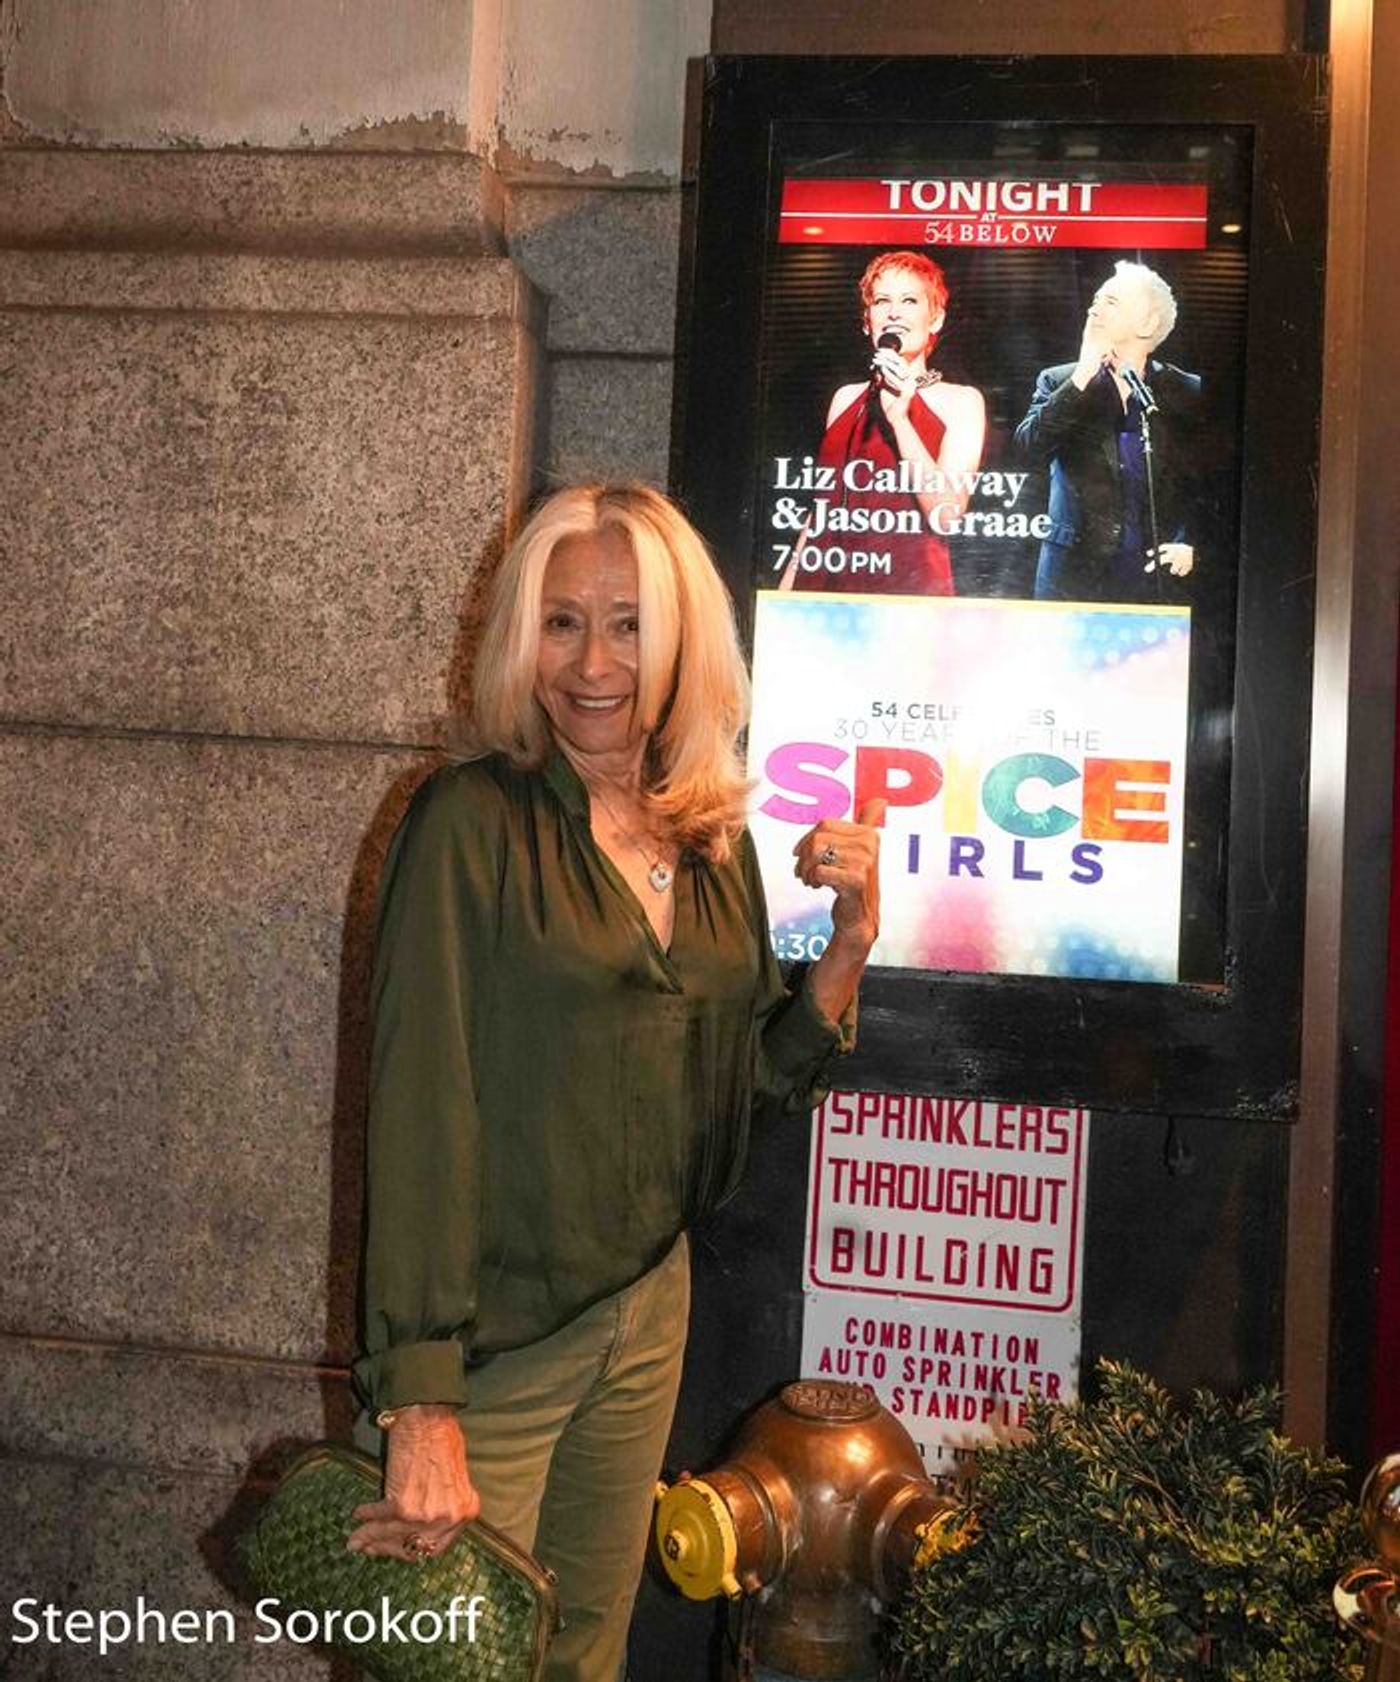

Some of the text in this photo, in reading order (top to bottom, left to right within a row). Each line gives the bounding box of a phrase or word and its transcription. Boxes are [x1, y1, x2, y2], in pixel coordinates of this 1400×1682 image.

[880, 179, 1102, 213] TONIGHT
[980, 211, 998, 223] AT
[924, 221, 1058, 244] 54 BELOW
[773, 456, 1029, 508] Liz Callaway
[928, 503, 1053, 539] Graae
[833, 718, 869, 741] 30
[1040, 727, 1101, 752] THE
[871, 700, 1056, 726] 54 CELES
[758, 742, 1171, 844] SPICE
[907, 833, 1104, 885] IRLS
[770, 933, 830, 961] :30
[830, 1090, 1070, 1155] SPRINKLERS
[828, 1156, 1067, 1226] THROUGHOUT
[830, 1226, 1054, 1295] BUILDING
[845, 1317, 1040, 1365] COMBINATION
[818, 1346, 887, 1380] AUTO
[902, 1355, 1062, 1401] SPRINKLER
[891, 1386, 1030, 1428] STANDPIP
